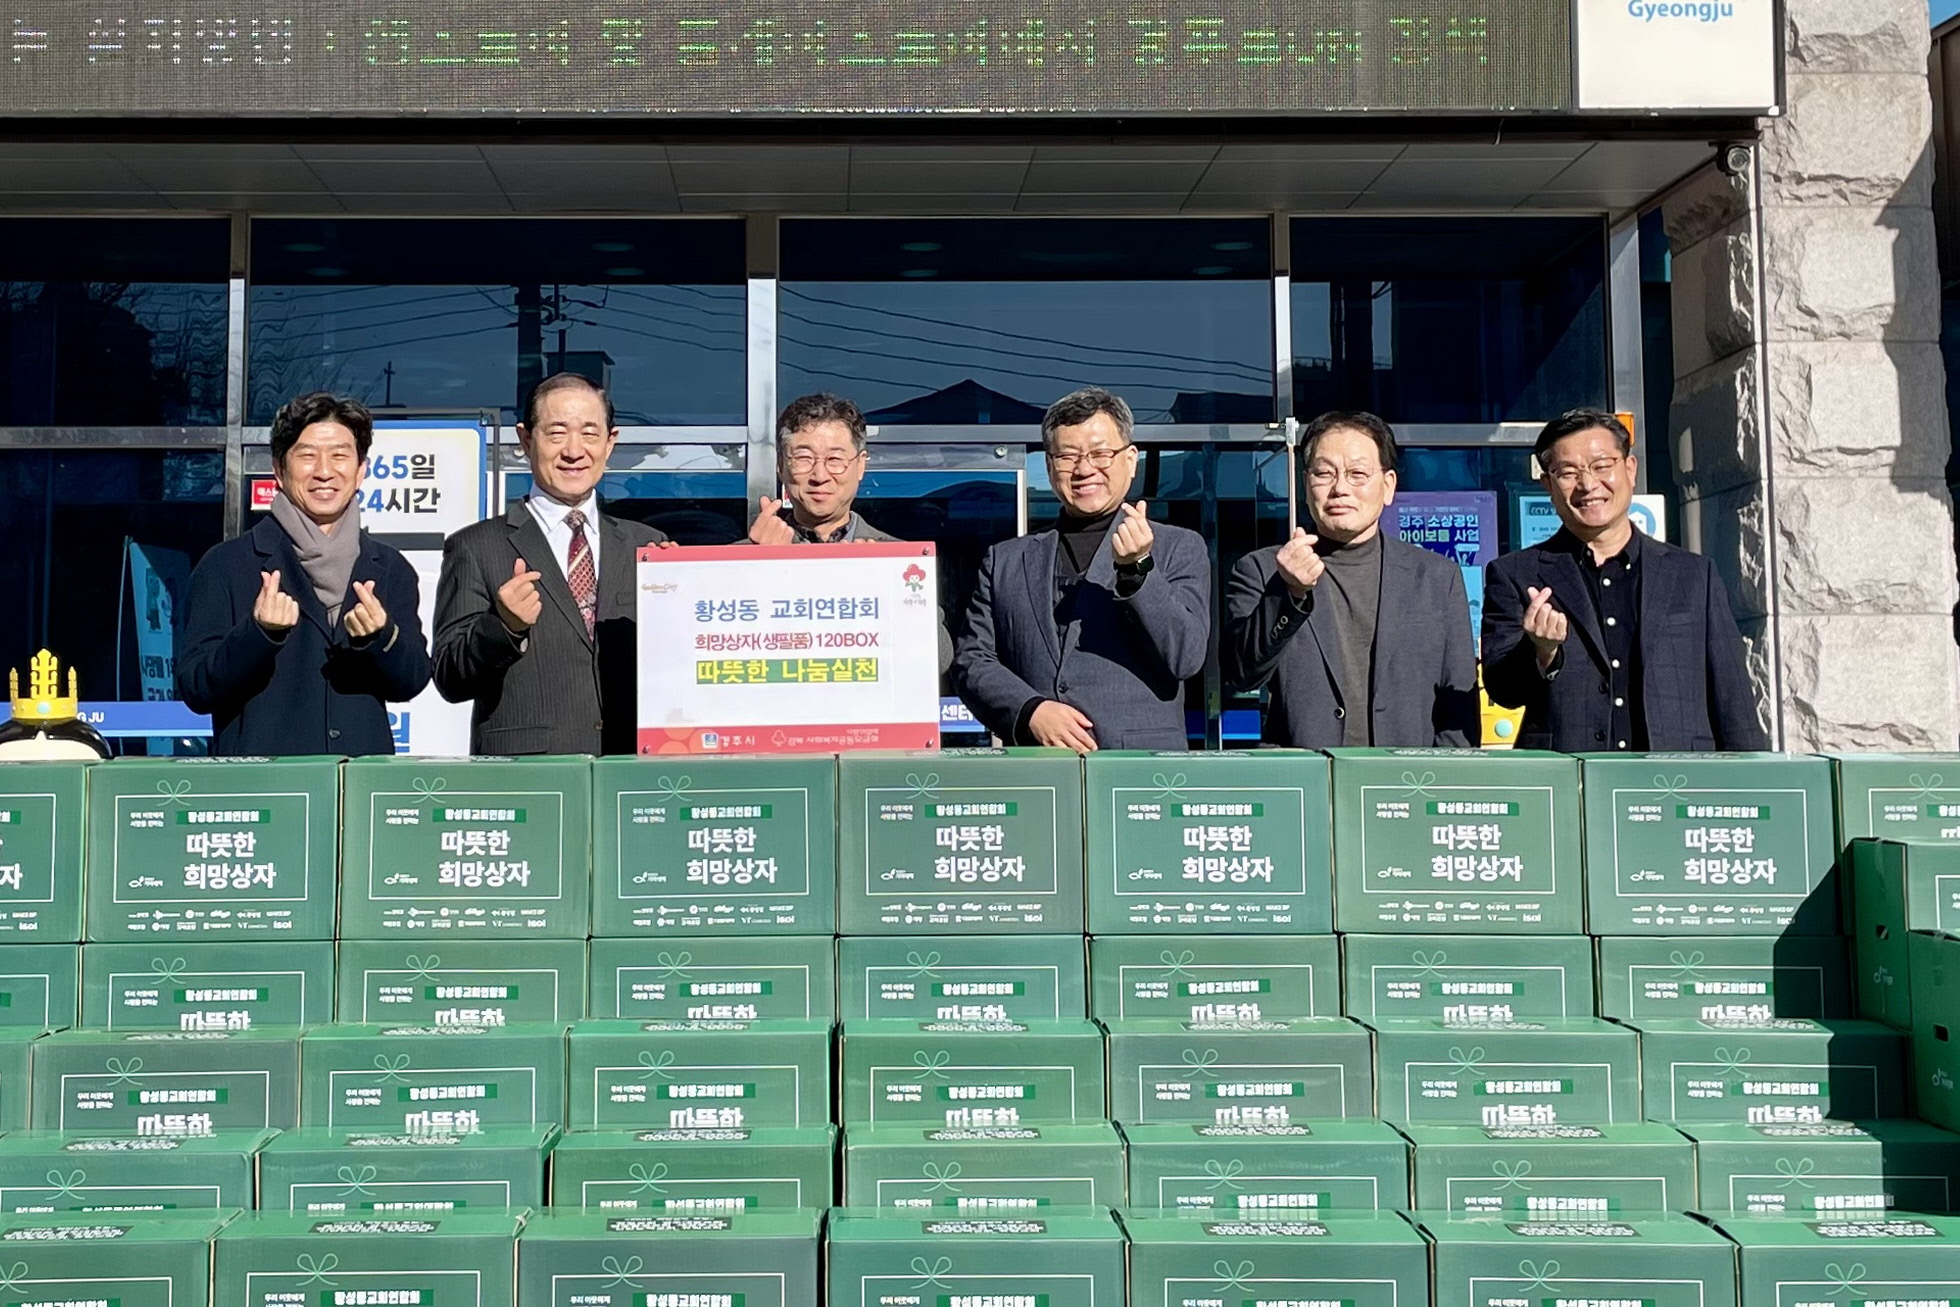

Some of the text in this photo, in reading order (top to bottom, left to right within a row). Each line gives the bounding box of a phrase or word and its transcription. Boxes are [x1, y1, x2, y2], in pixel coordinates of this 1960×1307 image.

[1628, 0, 1734, 22] Gyeongju
[1428, 513, 1479, 528] 소상공인
[694, 598, 760, 623] 황성동
[770, 596, 880, 621] 교회연합회
[697, 658, 878, 684] 따뜻한 나눔실천
[187, 832, 256, 857] 따뜻한
[442, 831, 510, 855] 따뜻한
[689, 828, 756, 852] 따뜻한
[937, 826, 1004, 850] 따뜻한
[1184, 826, 1252, 851] 따뜻한
[1433, 825, 1501, 850] 따뜻한
[1685, 828, 1754, 852] 따뜻한
[184, 863, 276, 888] 희망상자
[439, 861, 530, 886] 희망상자
[687, 859, 777, 884] 희망상자
[935, 857, 1025, 881] 희망상자
[1183, 857, 1274, 882] 희망상자
[1432, 856, 1523, 881] 희망상자
[1684, 859, 1777, 884] 희망상자
